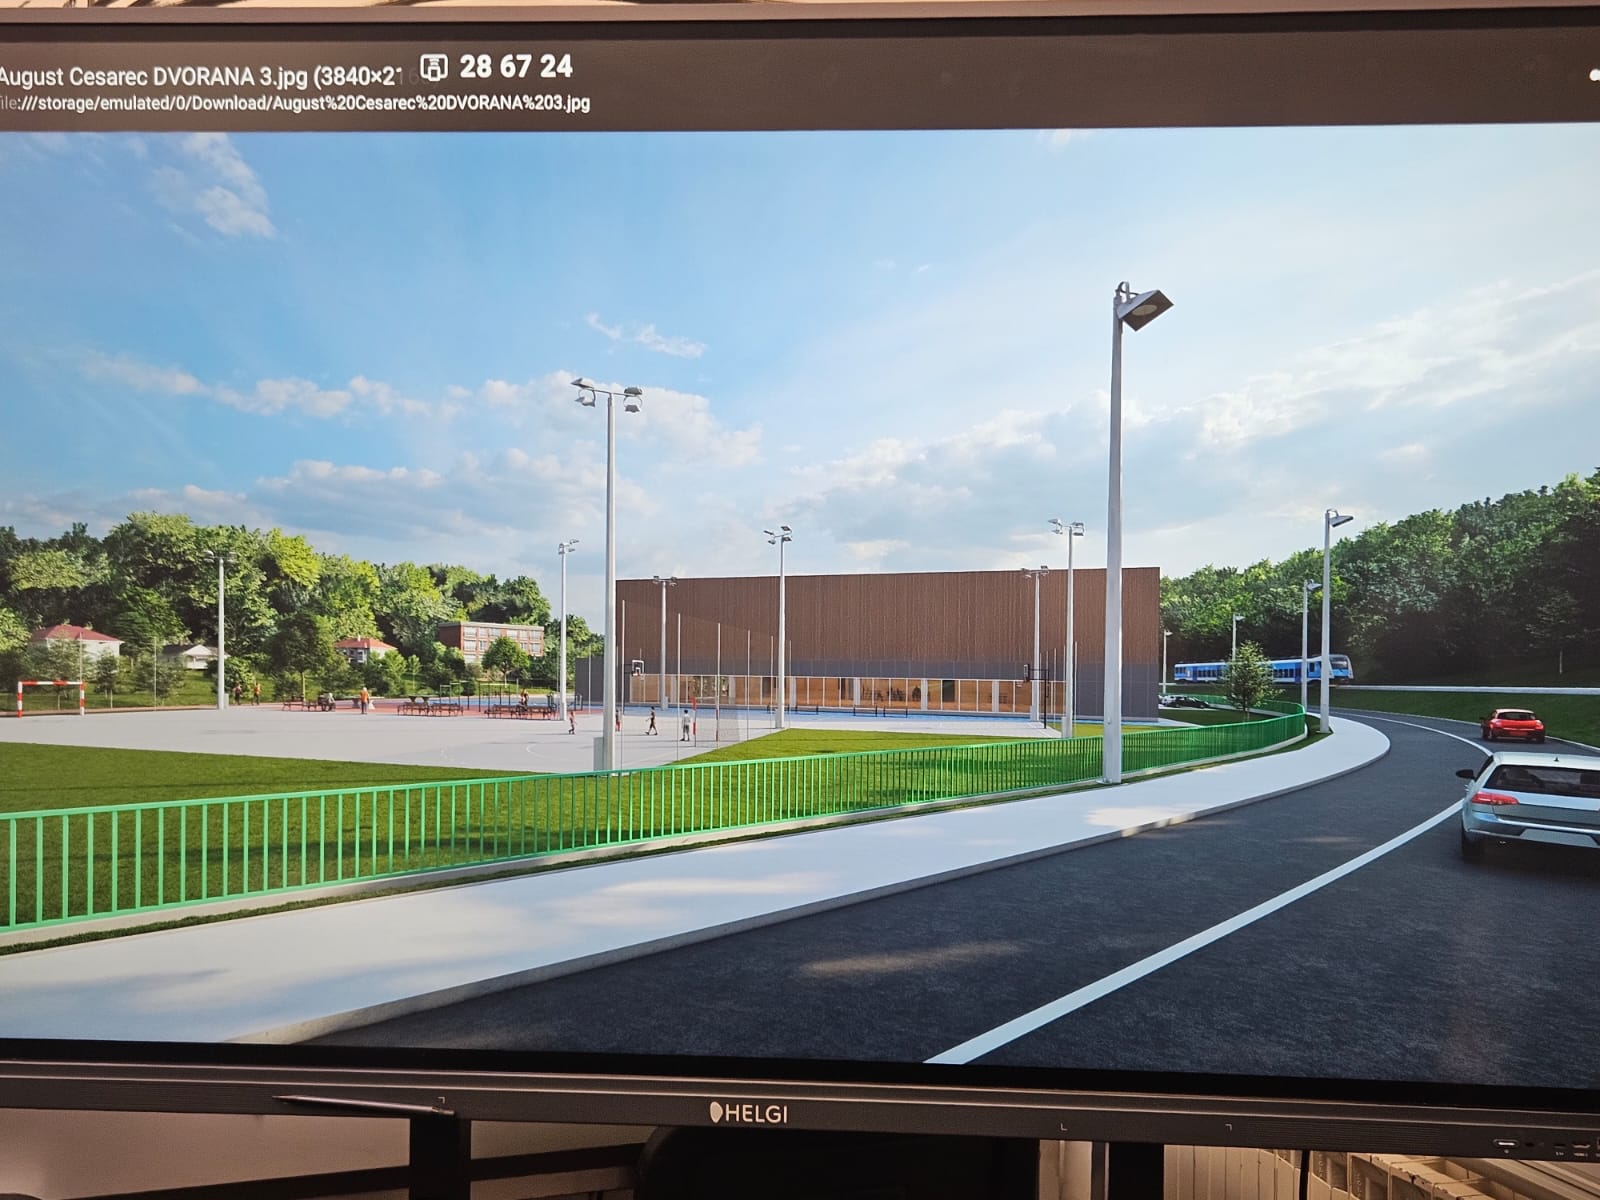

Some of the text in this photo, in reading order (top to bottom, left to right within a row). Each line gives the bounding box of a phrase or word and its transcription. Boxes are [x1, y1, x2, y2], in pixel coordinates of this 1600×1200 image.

[0, 66, 63, 90] August
[69, 66, 148, 86] Cesarec
[153, 66, 255, 86] DVORANA
[260, 66, 308, 90] 3.jpg
[459, 54, 573, 78] 28 67 24
[725, 1103, 788, 1124] HELGI
